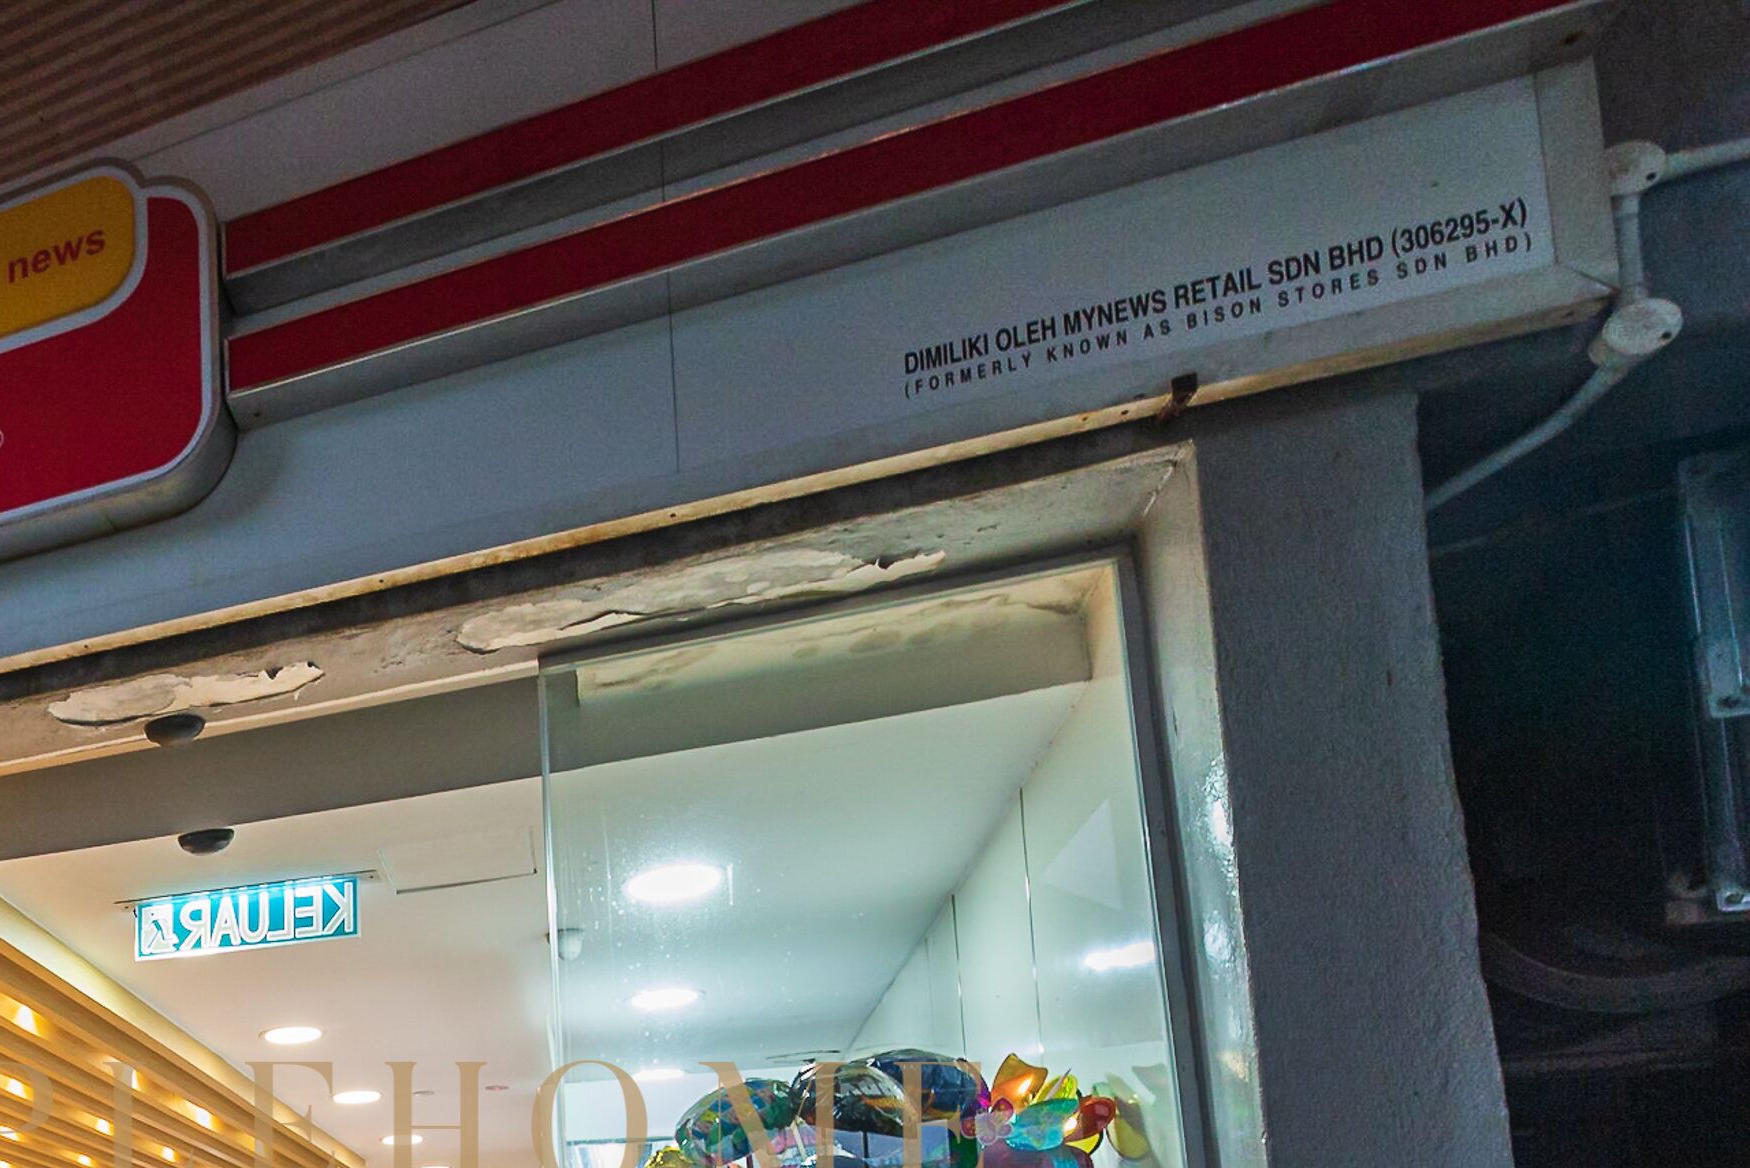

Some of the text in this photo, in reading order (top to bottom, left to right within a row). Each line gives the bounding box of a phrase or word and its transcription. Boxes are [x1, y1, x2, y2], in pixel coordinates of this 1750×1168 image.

[7, 226, 107, 284] news
[903, 197, 1528, 375] DIMILIKI OLEH MYNEWS RETAIL SDN BHD (306295-X)
[904, 232, 1533, 399] (FORMERLY KNOWN AS BISON STORES SDN BHD)
